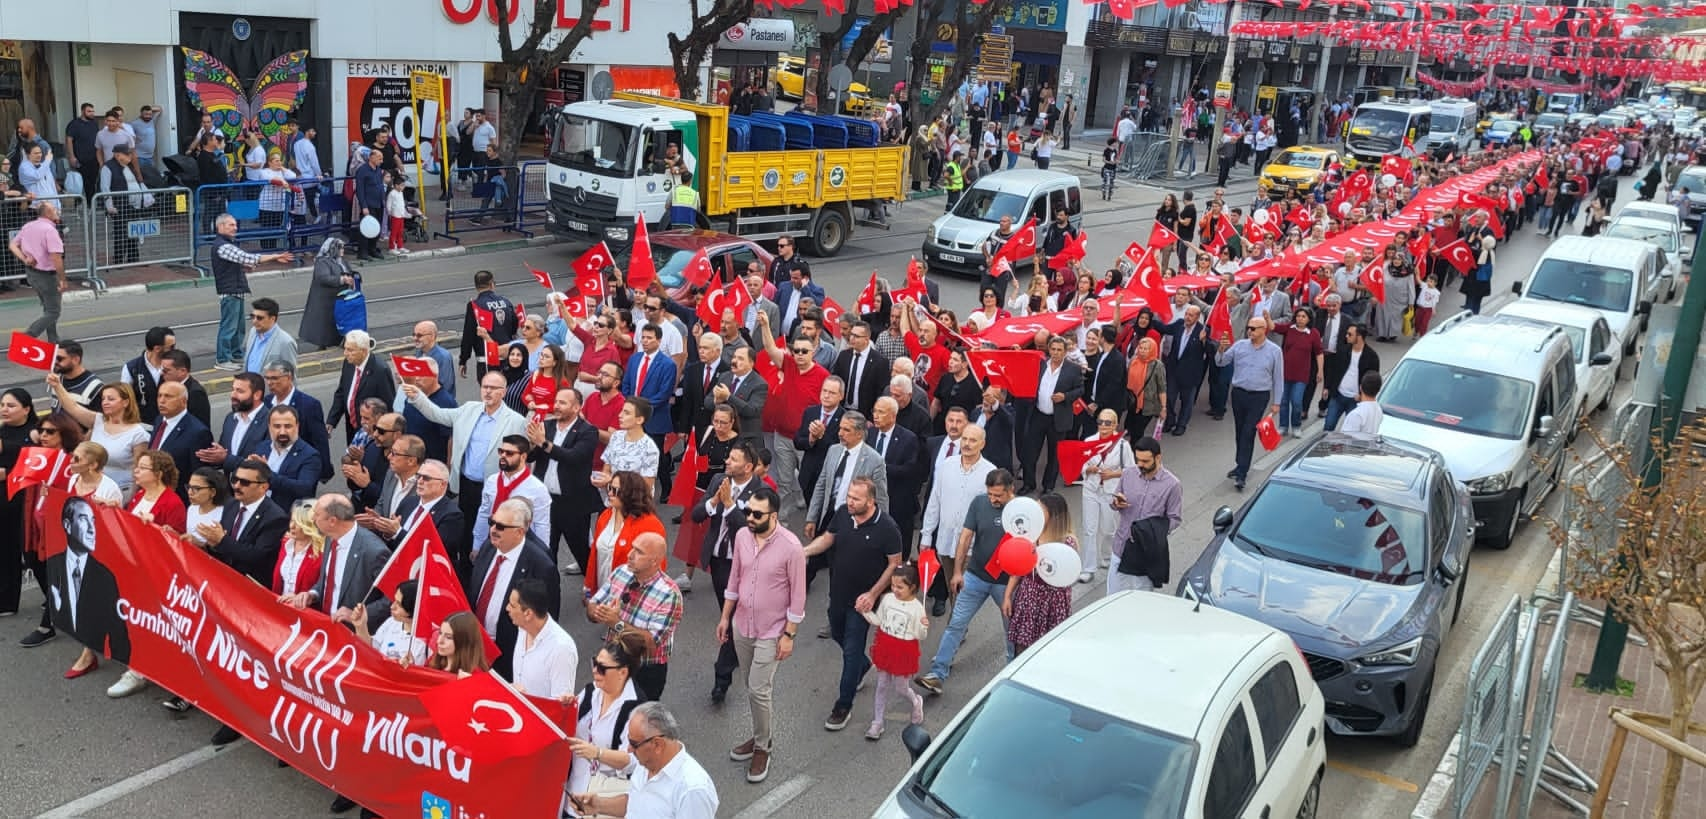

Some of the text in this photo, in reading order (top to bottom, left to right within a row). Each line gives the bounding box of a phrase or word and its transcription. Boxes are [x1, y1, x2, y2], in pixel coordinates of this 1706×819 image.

[751, 28, 787, 41] Pastanesi
[348, 62, 397, 76] EFSANE
[206, 624, 270, 690] Nice
